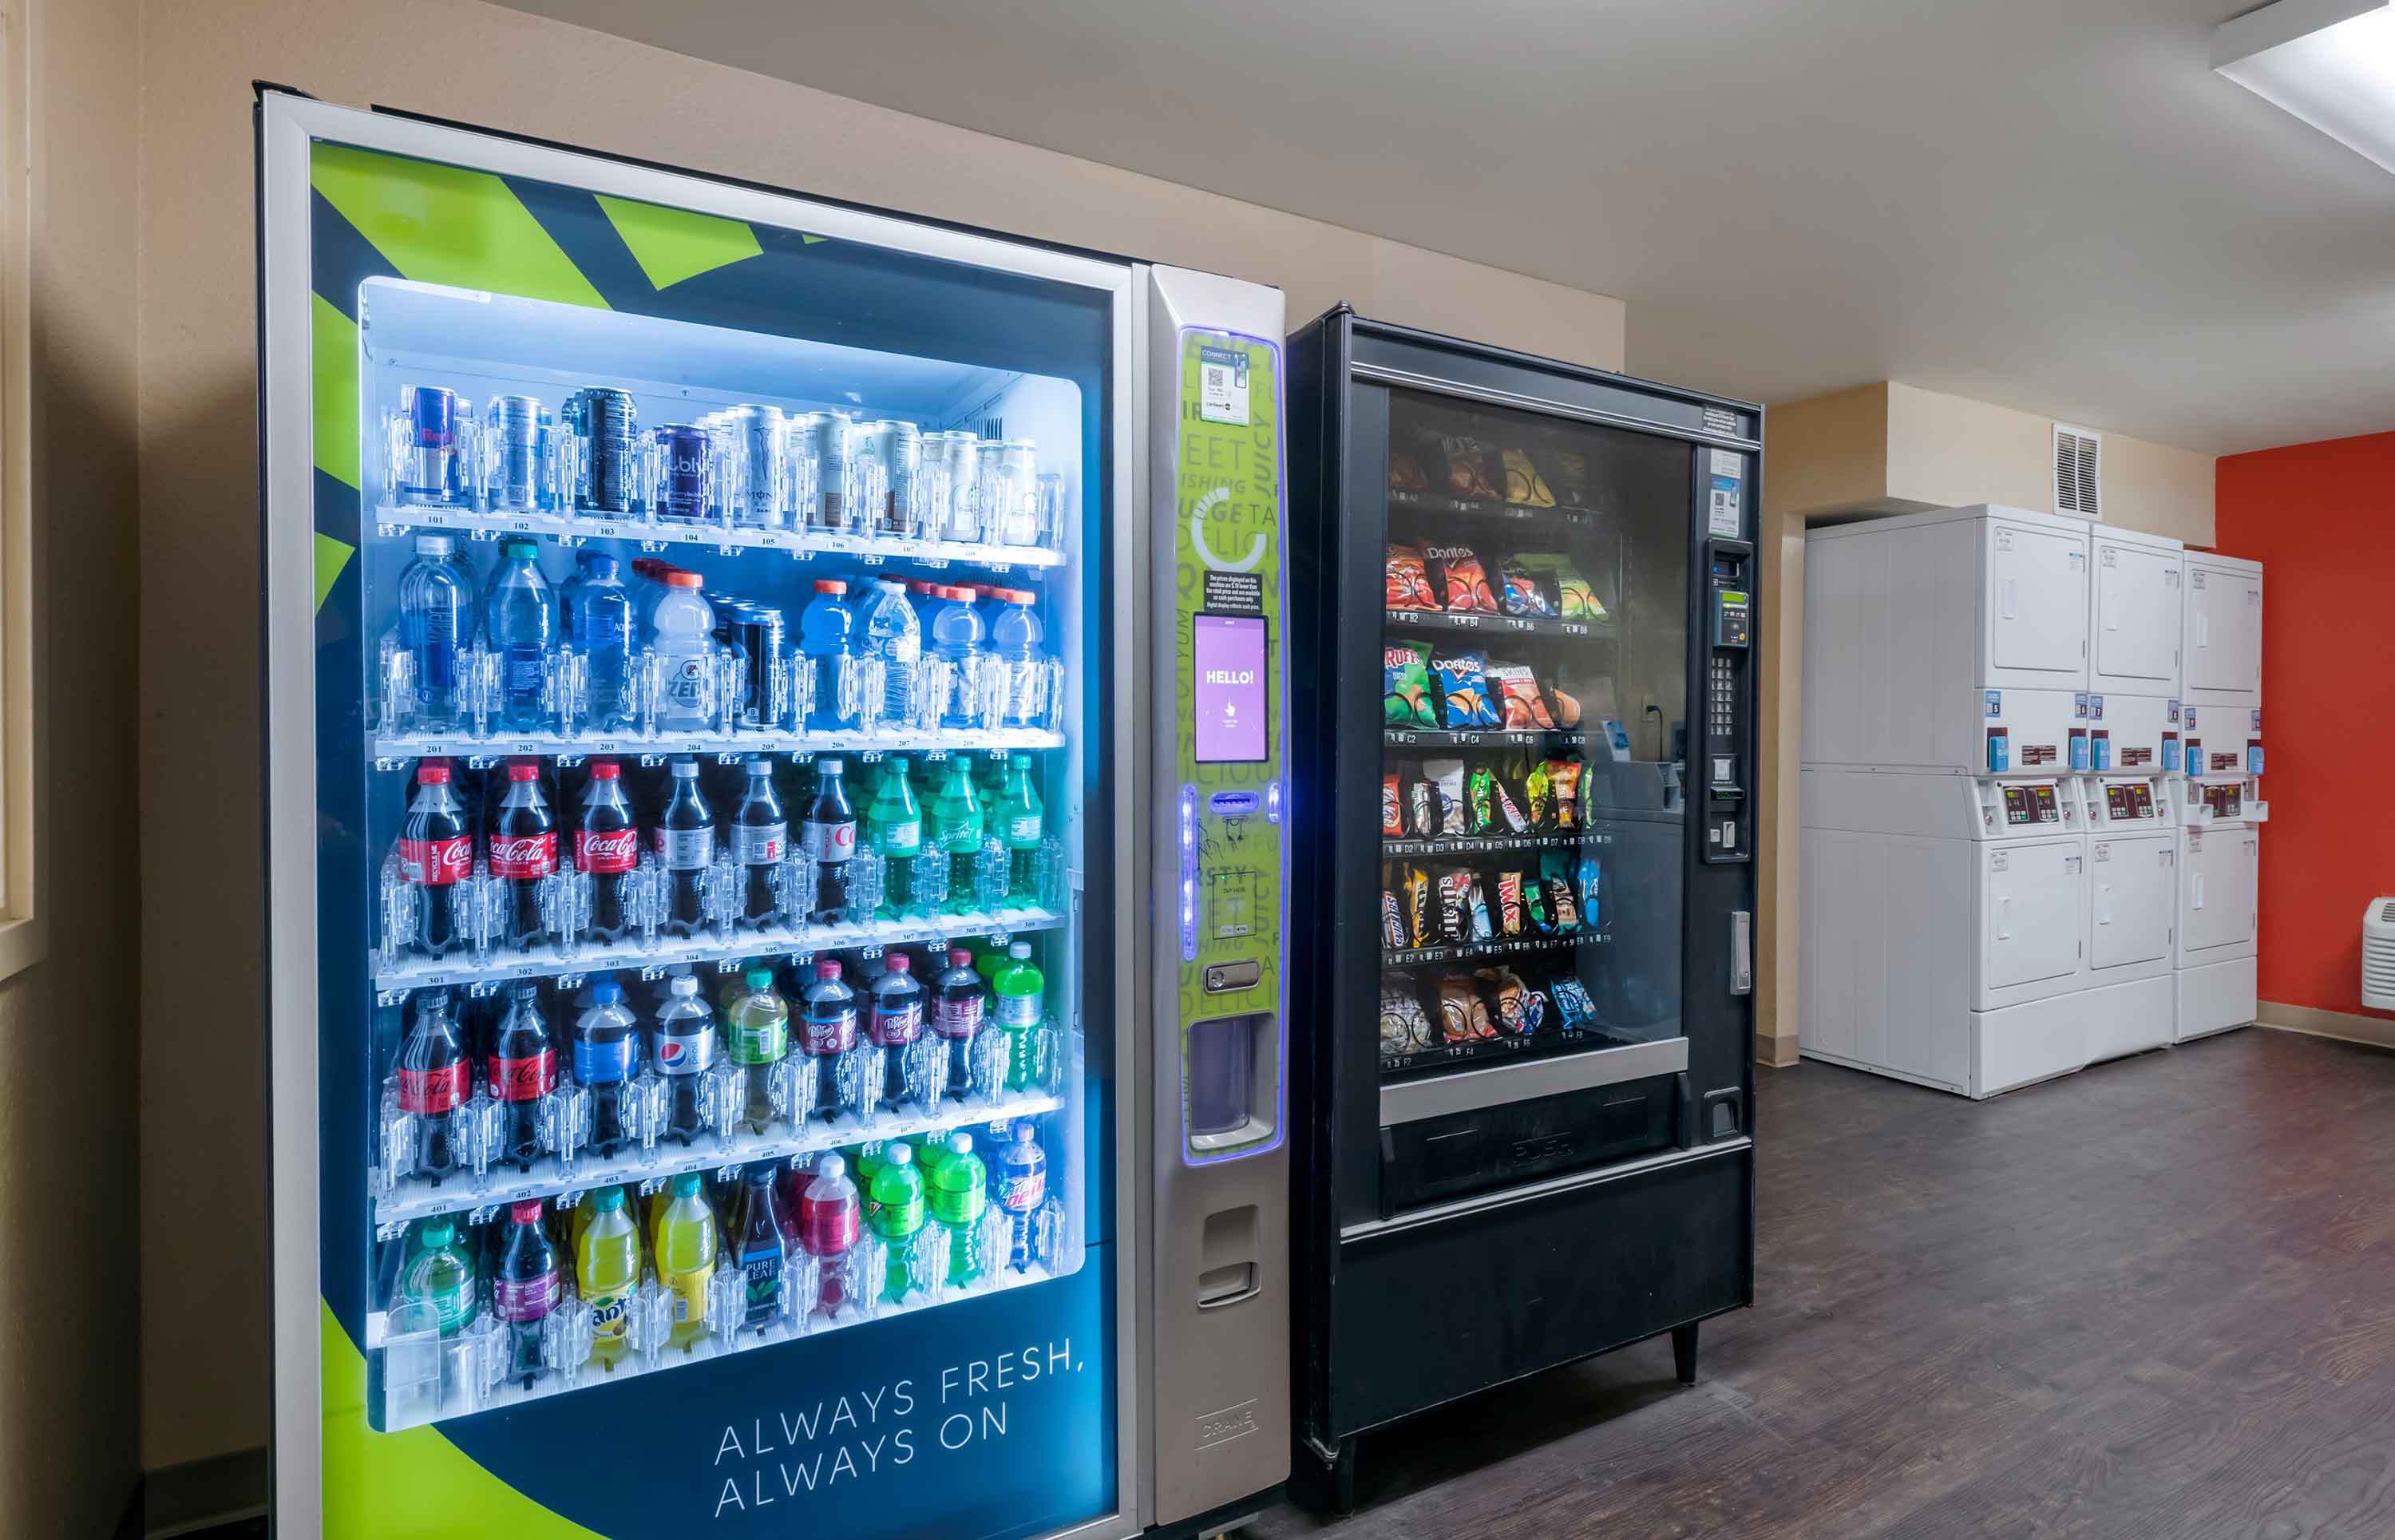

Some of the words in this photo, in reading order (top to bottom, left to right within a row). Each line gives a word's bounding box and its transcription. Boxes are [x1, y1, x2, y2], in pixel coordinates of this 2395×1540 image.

[427, 516, 443, 525] 101
[1427, 546, 1474, 559] Doritos
[1410, 615, 1419, 624] B2
[1432, 659, 1481, 672] Doritos
[1206, 670, 1254, 684] HELLO!
[1407, 734, 1416, 743] C2
[1471, 735, 1479, 744] C4
[1526, 735, 1534, 744] C6
[1523, 839, 1532, 848] D6
[1405, 844, 1414, 853] D2
[1498, 875, 1517, 923] TWIX
[1406, 954, 1415, 963] E2
[517, 968, 533, 976] 302
[1466, 1047, 1474, 1056] F4
[430, 1205, 447, 1213] 401
[516, 1190, 532, 1199] 402
[683, 1163, 698, 1172] 404
[746, 1259, 777, 1272] PURE
[715, 1380, 915, 1466] ALWAYS
[941, 1338, 1085, 1403] FRESH,
[715, 1429, 915, 1518] ALWAYS
[940, 1401, 1006, 1450] ON
